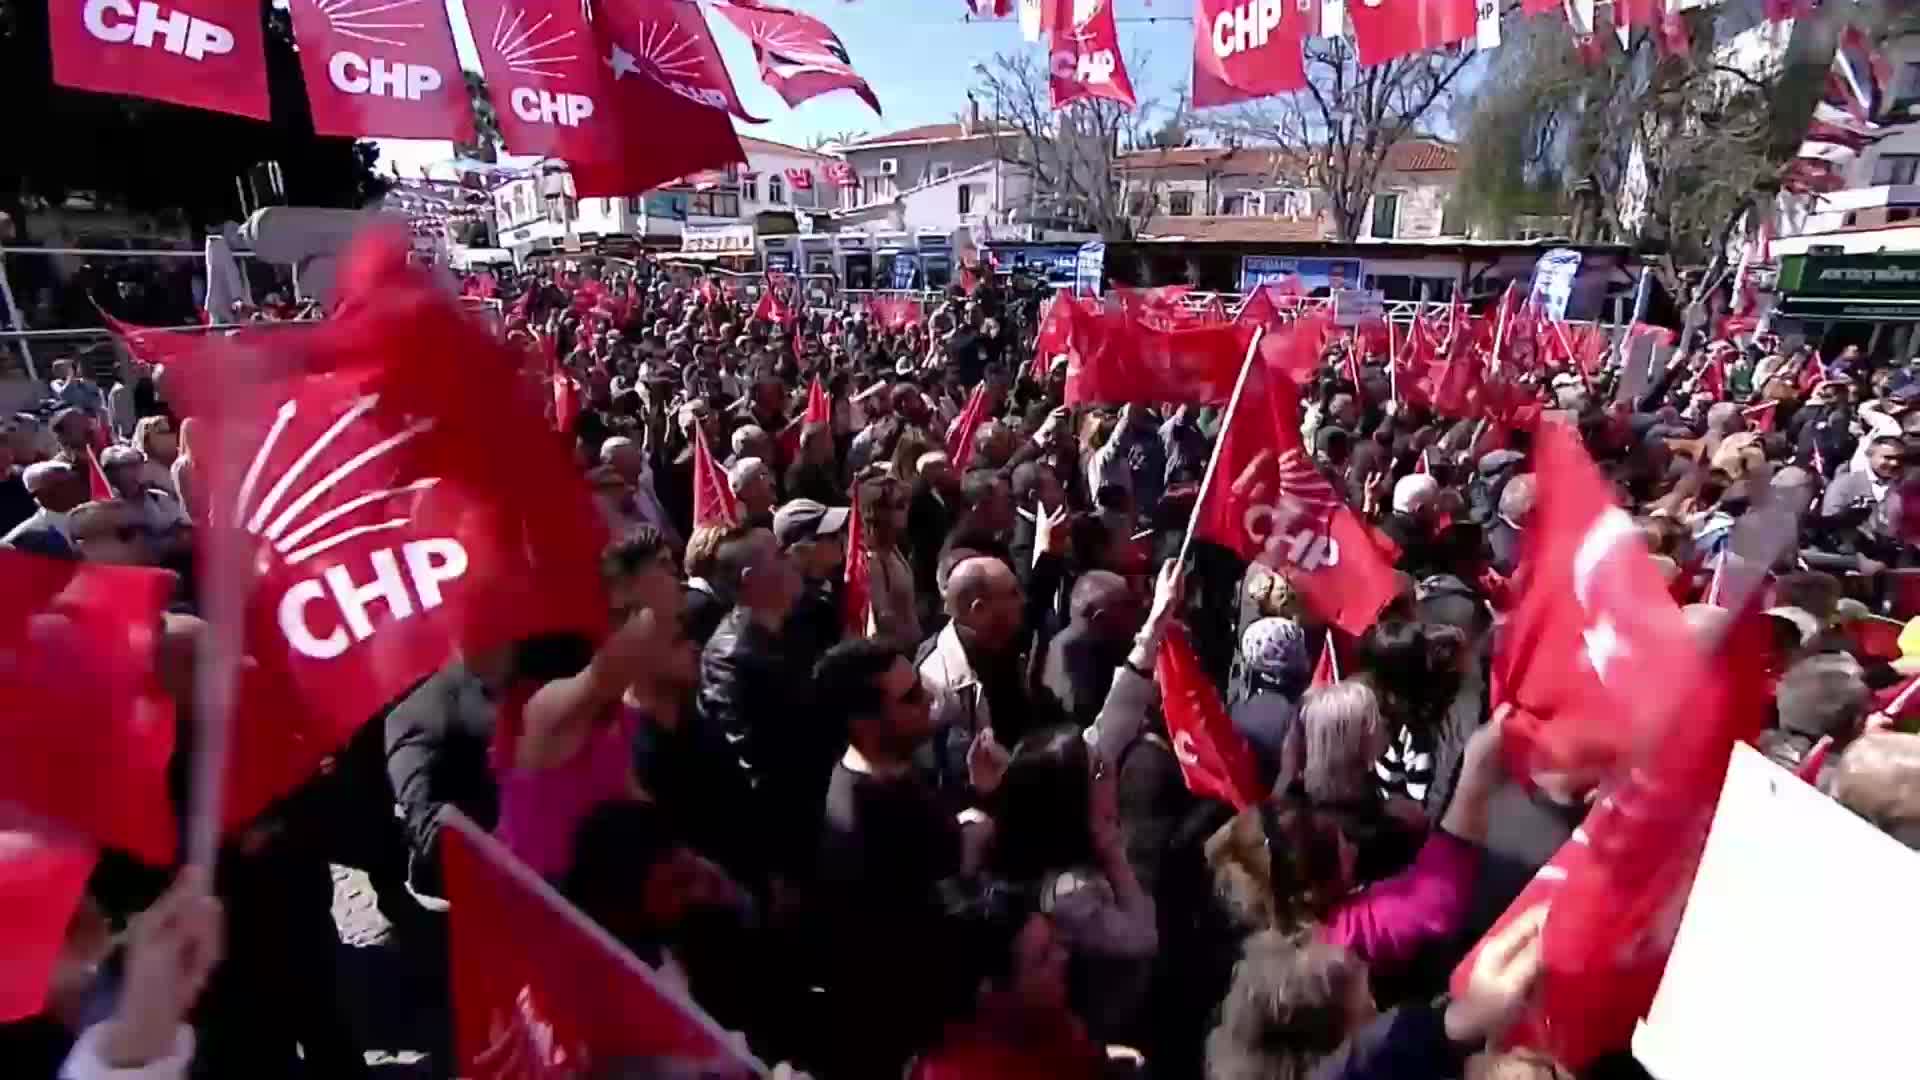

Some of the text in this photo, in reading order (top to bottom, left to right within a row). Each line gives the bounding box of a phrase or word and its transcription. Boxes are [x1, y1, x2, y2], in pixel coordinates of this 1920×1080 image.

[83, 0, 235, 62] CHP
[1212, 0, 1282, 57] CHP
[327, 50, 443, 101] CHP
[510, 86, 595, 128] CHP
[279, 537, 468, 659] CHP
